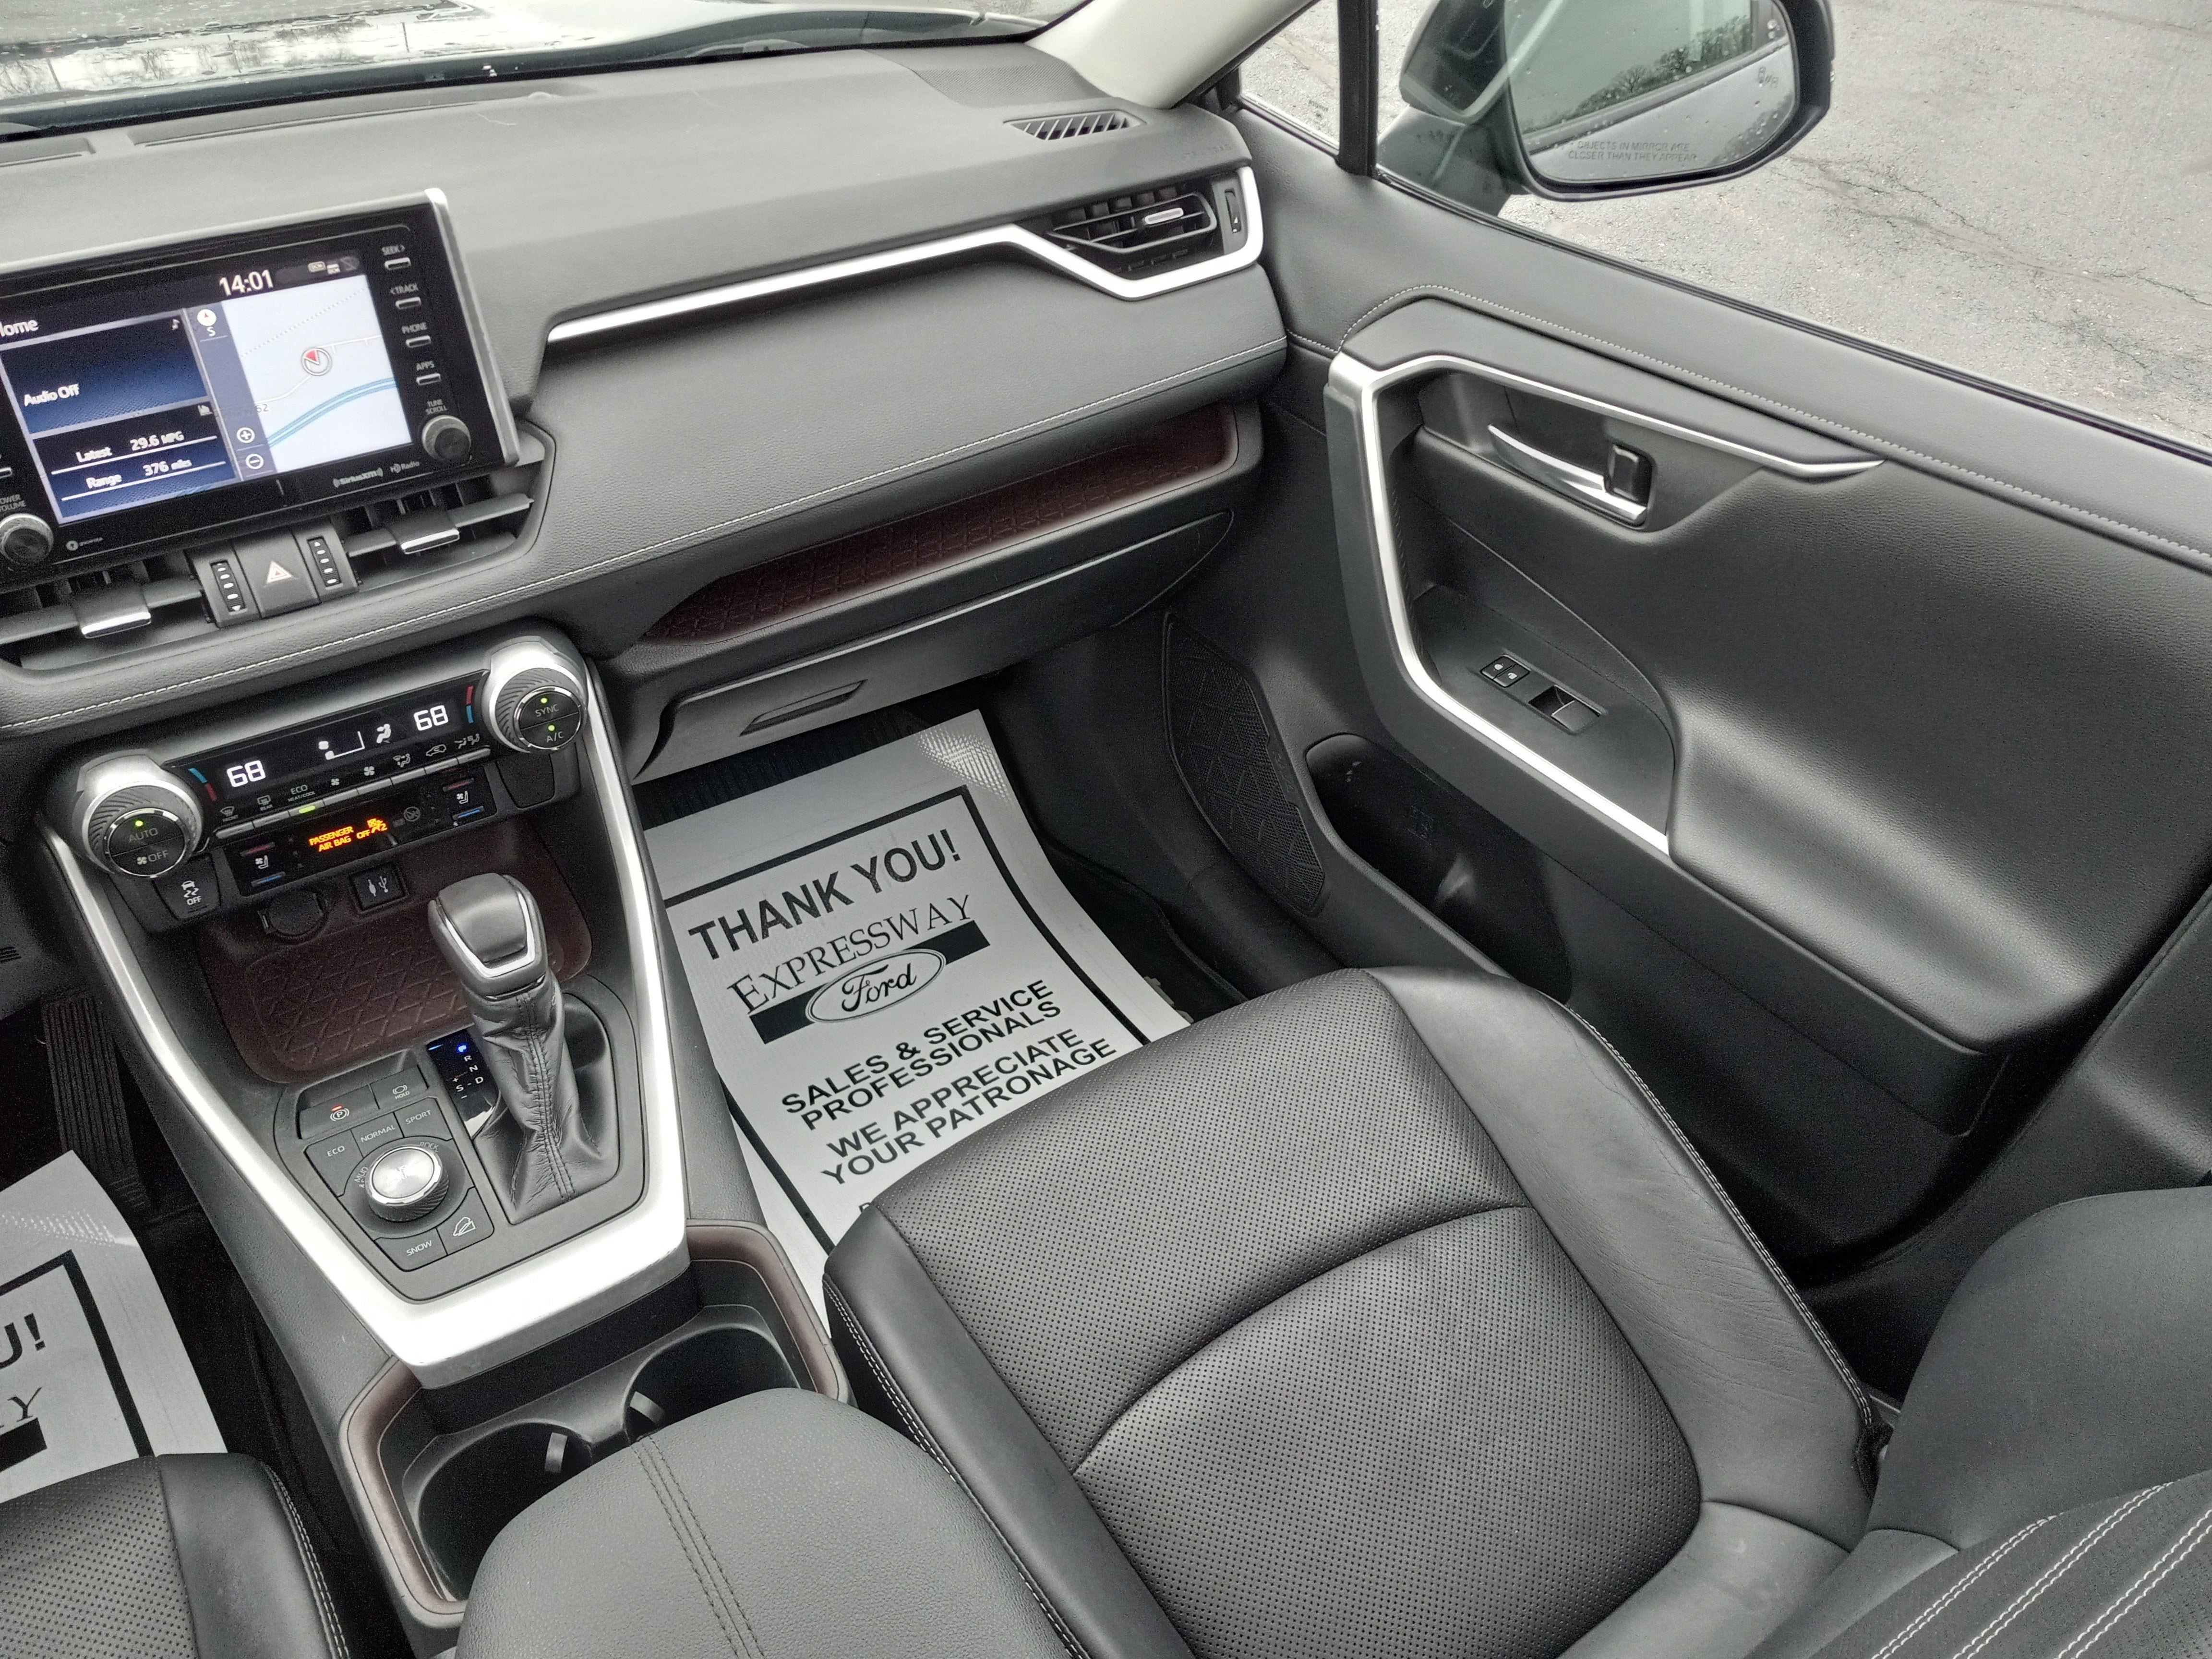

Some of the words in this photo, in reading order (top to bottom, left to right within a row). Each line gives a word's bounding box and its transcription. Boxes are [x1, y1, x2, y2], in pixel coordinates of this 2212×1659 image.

[1577, 141, 1616, 150] OBJECTS
[1619, 142, 1629, 150] IN
[1632, 142, 1668, 152] MIRROR
[1671, 143, 1689, 152] ARE
[1568, 150, 1604, 160] CLOSER
[1608, 151, 1631, 161] THAN
[1634, 152, 1657, 161] THEY
[1658, 152, 1697, 162] APPEAR
[219, 269, 274, 297] 14:01
[207, 326, 216, 337] S
[401, 322, 427, 334] PHONE
[416, 360, 435, 371] APPS
[24, 391, 58, 407] Audio
[58, 384, 80, 399] Off
[427, 398, 443, 408] TUNE
[425, 405, 448, 416] SCROLL
[76, 446, 113, 463] Latest
[130, 436, 160, 451] 29.6
[161, 431, 185, 445] MPG
[400, 461, 420, 470] Radio
[85, 473, 123, 490] Range
[143, 461, 169, 477] 376
[0, 493, 21, 504] OWER
[0, 500, 26, 512] OLUME
[413, 704, 449, 731] 68
[534, 704, 559, 718] SYNC
[546, 731, 565, 744] A/C
[226, 760, 266, 788] 68
[290, 784, 308, 795] ECO
[128, 827, 158, 843] AUTO
[309, 826, 354, 846] PASSENGER
[356, 829, 371, 839] OFF
[318, 842, 334, 852] AIR
[333, 835, 351, 847] BAG
[148, 850, 168, 863] OFF
[186, 895, 202, 906] OFF
[688, 871, 854, 960] THANK
[850, 829, 961, 893] YOU!
[727, 895, 971, 1014] EXPRESSWAY
[842, 962, 917, 1012] Ford
[781, 1055, 889, 1113] SALES
[896, 1041, 921, 1060] &
[924, 980, 1054, 1045] SERVICE
[801, 1001, 1061, 1130] PROFESSIONALS
[394, 1089, 410, 1100] HOLD
[826, 1121, 888, 1158] WE
[893, 1028, 1084, 1131] APPRECIATE
[405, 1109, 432, 1125] SPORT
[821, 1131, 926, 1185] YOUR
[925, 1038, 1117, 1138] PATRONAGE
[361, 1124, 396, 1143] NORMAL
[327, 1145, 345, 1157] ECO
[354, 1166, 369, 1183] MUD
[406, 1239, 433, 1257] SNOW
